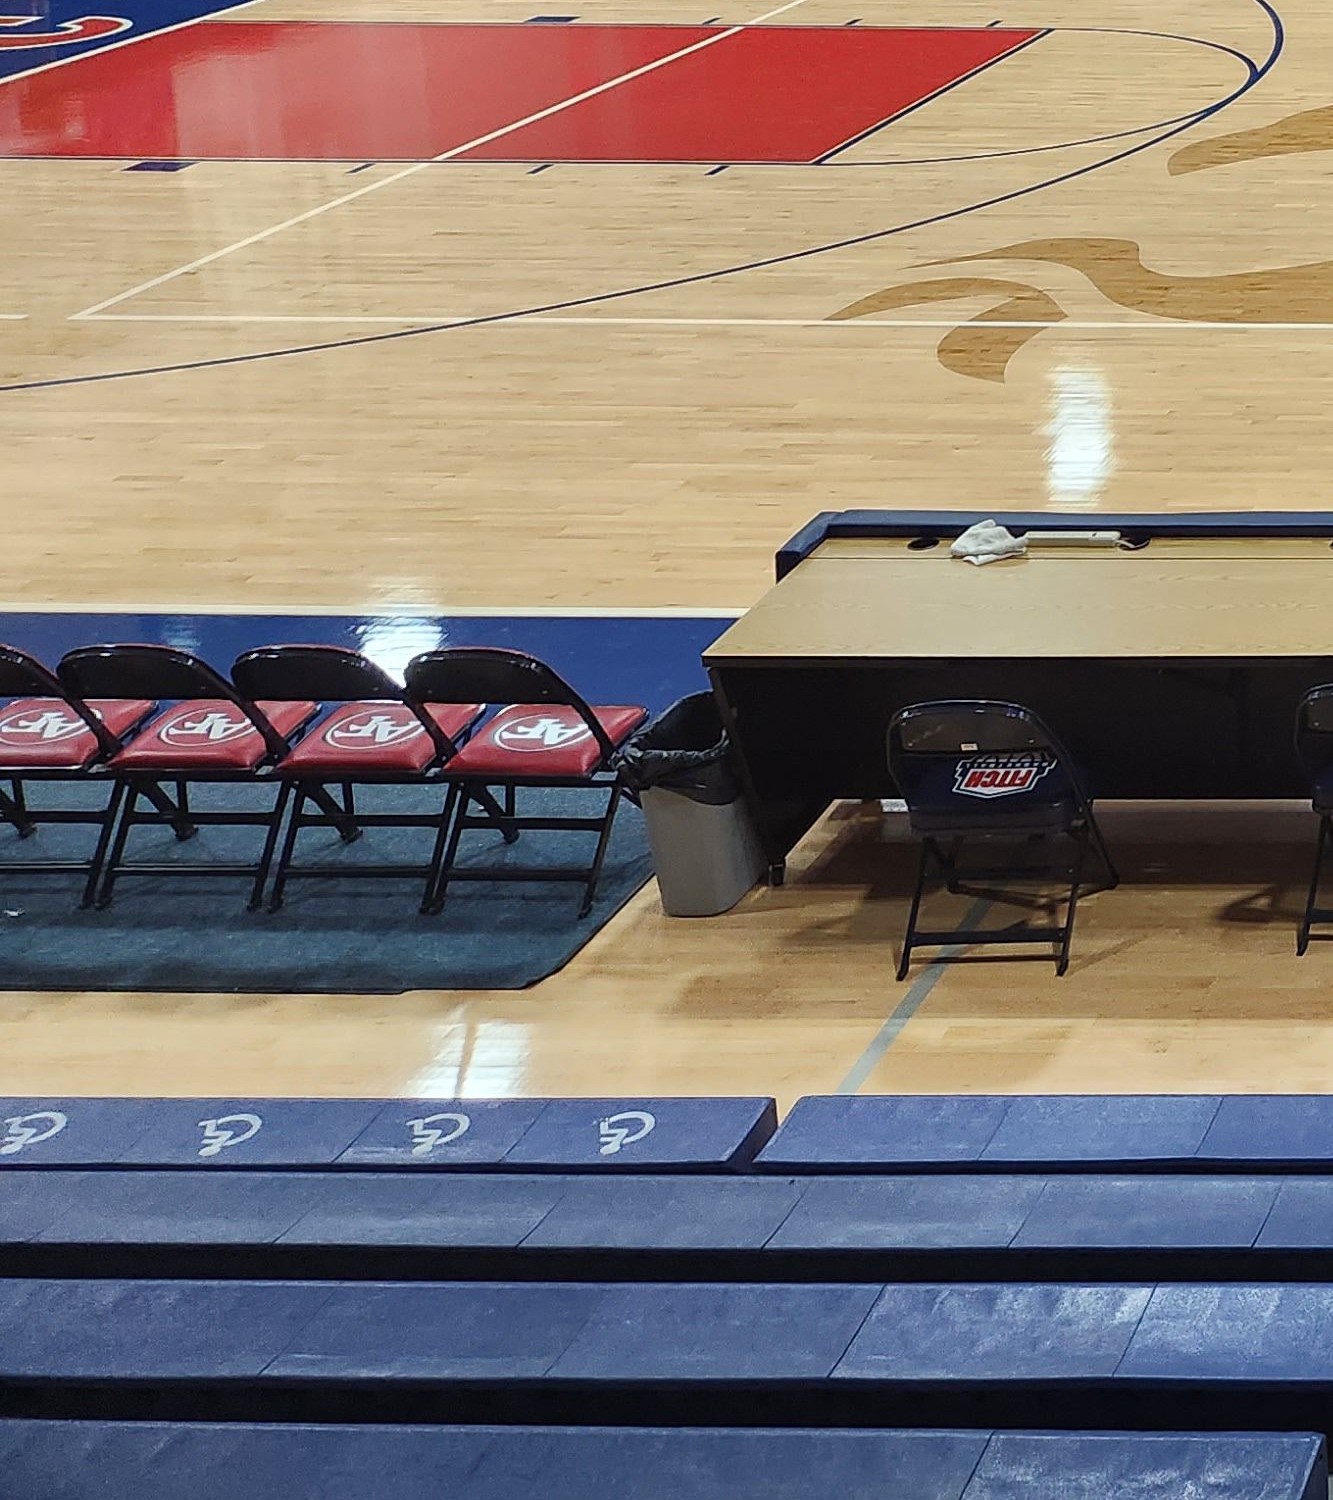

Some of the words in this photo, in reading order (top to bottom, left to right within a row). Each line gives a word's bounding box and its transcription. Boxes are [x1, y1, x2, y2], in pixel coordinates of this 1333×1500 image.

[2, 712, 86, 739] AF
[168, 713, 251, 740] AF
[334, 715, 423, 743] AF
[502, 718, 589, 745] AF
[964, 769, 1035, 789] FITCH
